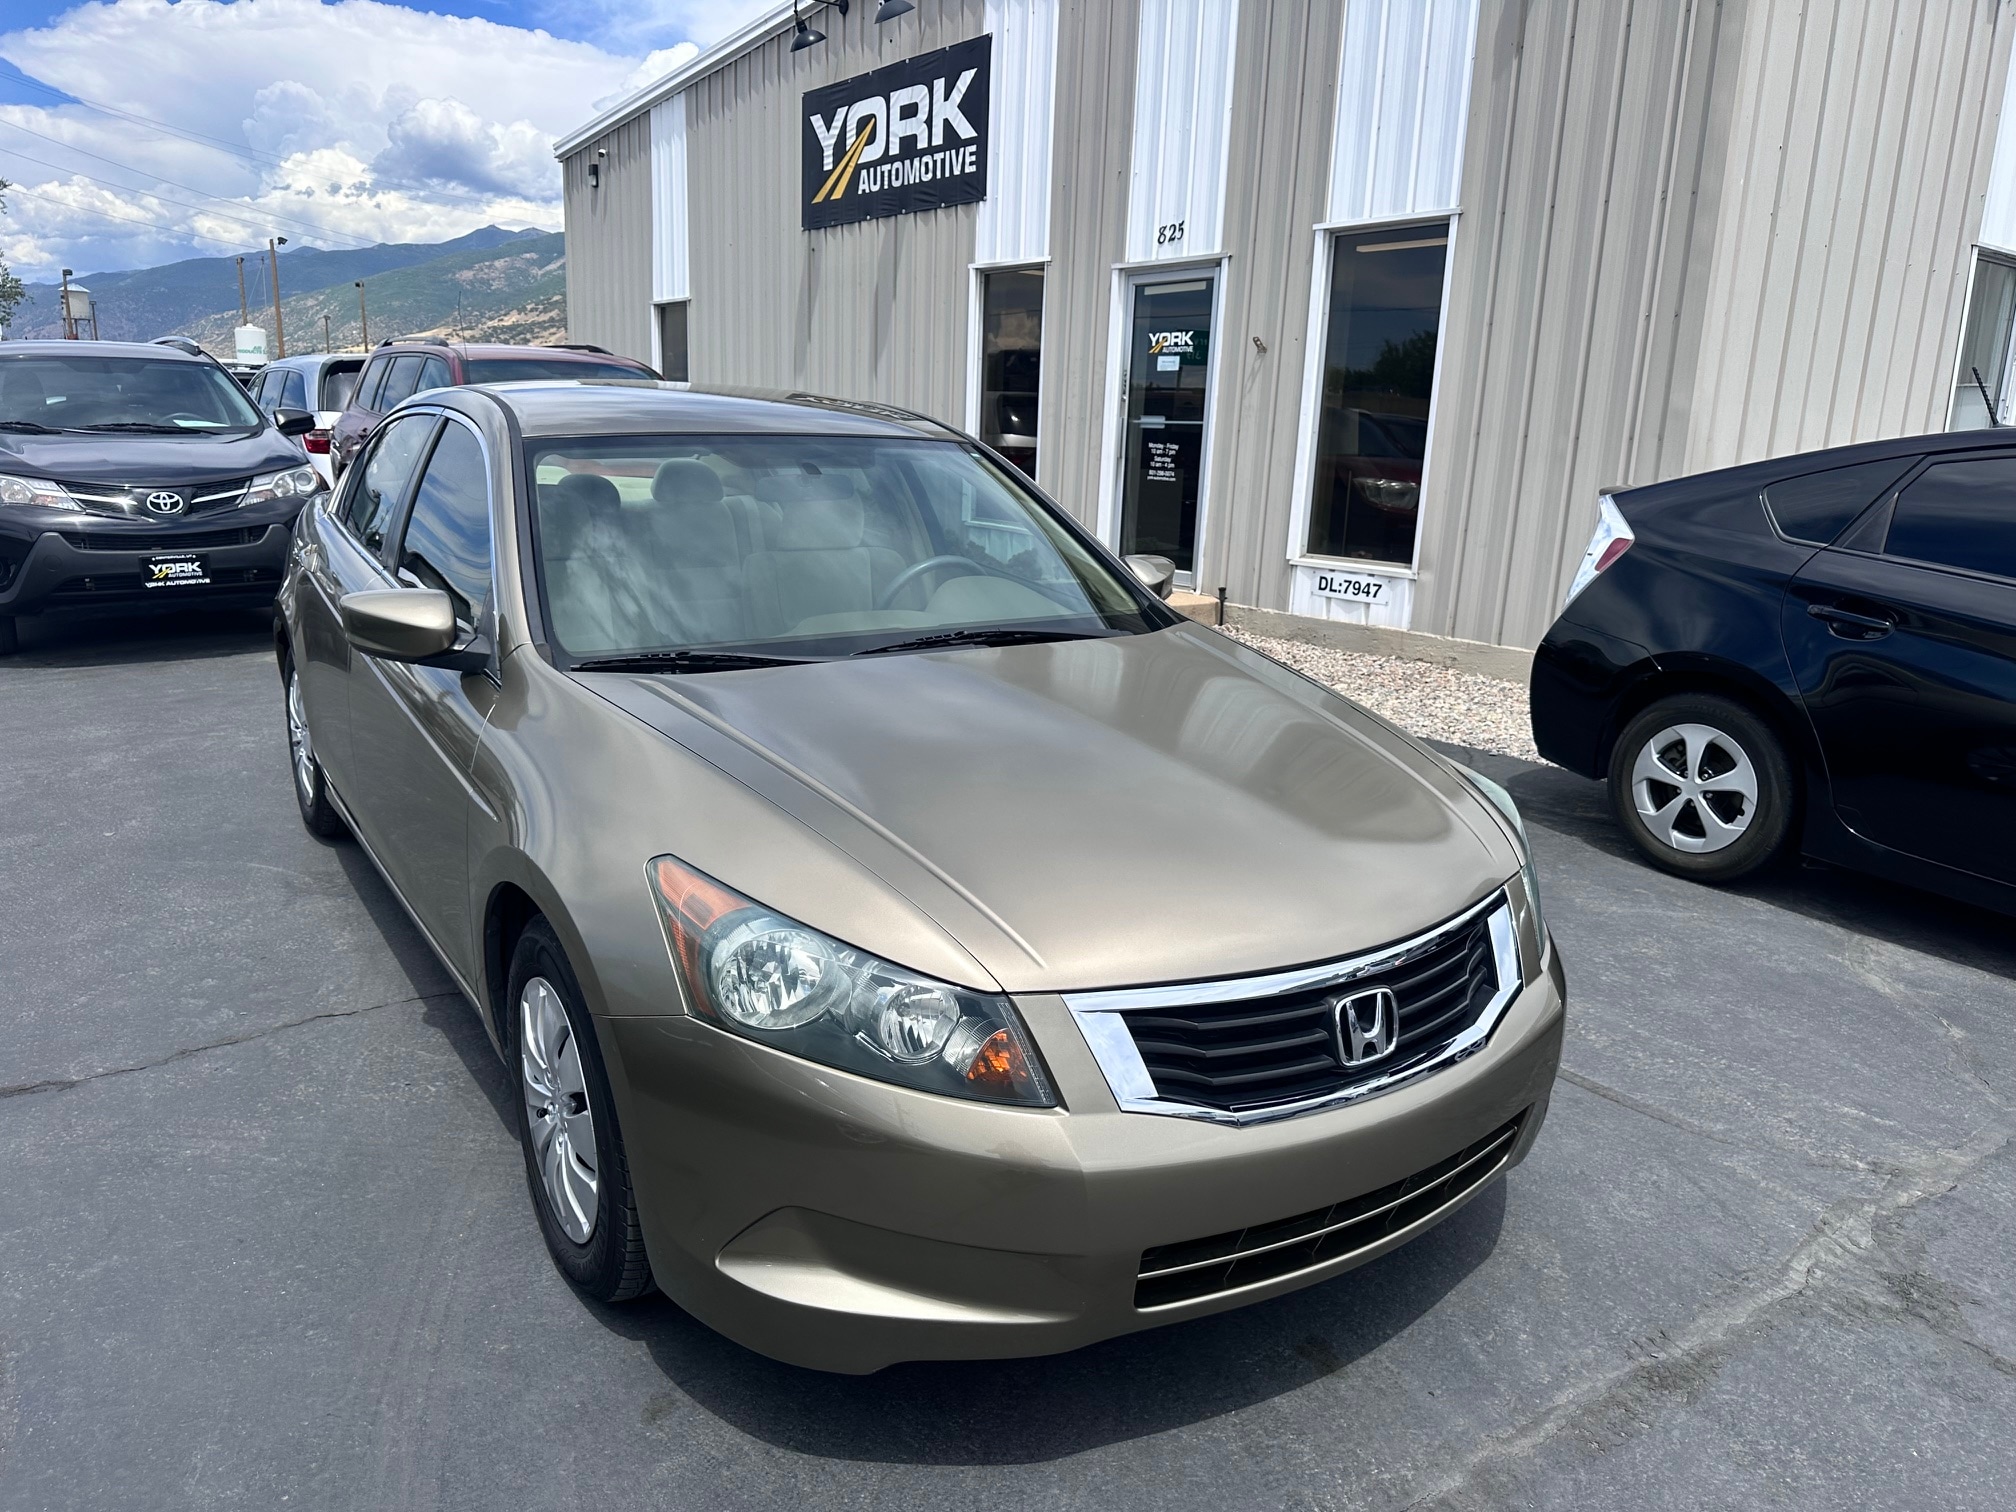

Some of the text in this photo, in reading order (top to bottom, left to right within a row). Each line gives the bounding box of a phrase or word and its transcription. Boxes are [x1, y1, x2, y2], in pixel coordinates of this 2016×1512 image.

[809, 67, 978, 172] YORK
[857, 144, 977, 194] AUTOMOTIVE
[1157, 220, 1185, 245] 825
[1148, 331, 1194, 347] YORK
[1148, 442, 1164, 450] Monday
[1154, 455, 1171, 463] Saturday
[149, 562, 202, 574] YORK
[1318, 575, 1382, 599] DL:7947
